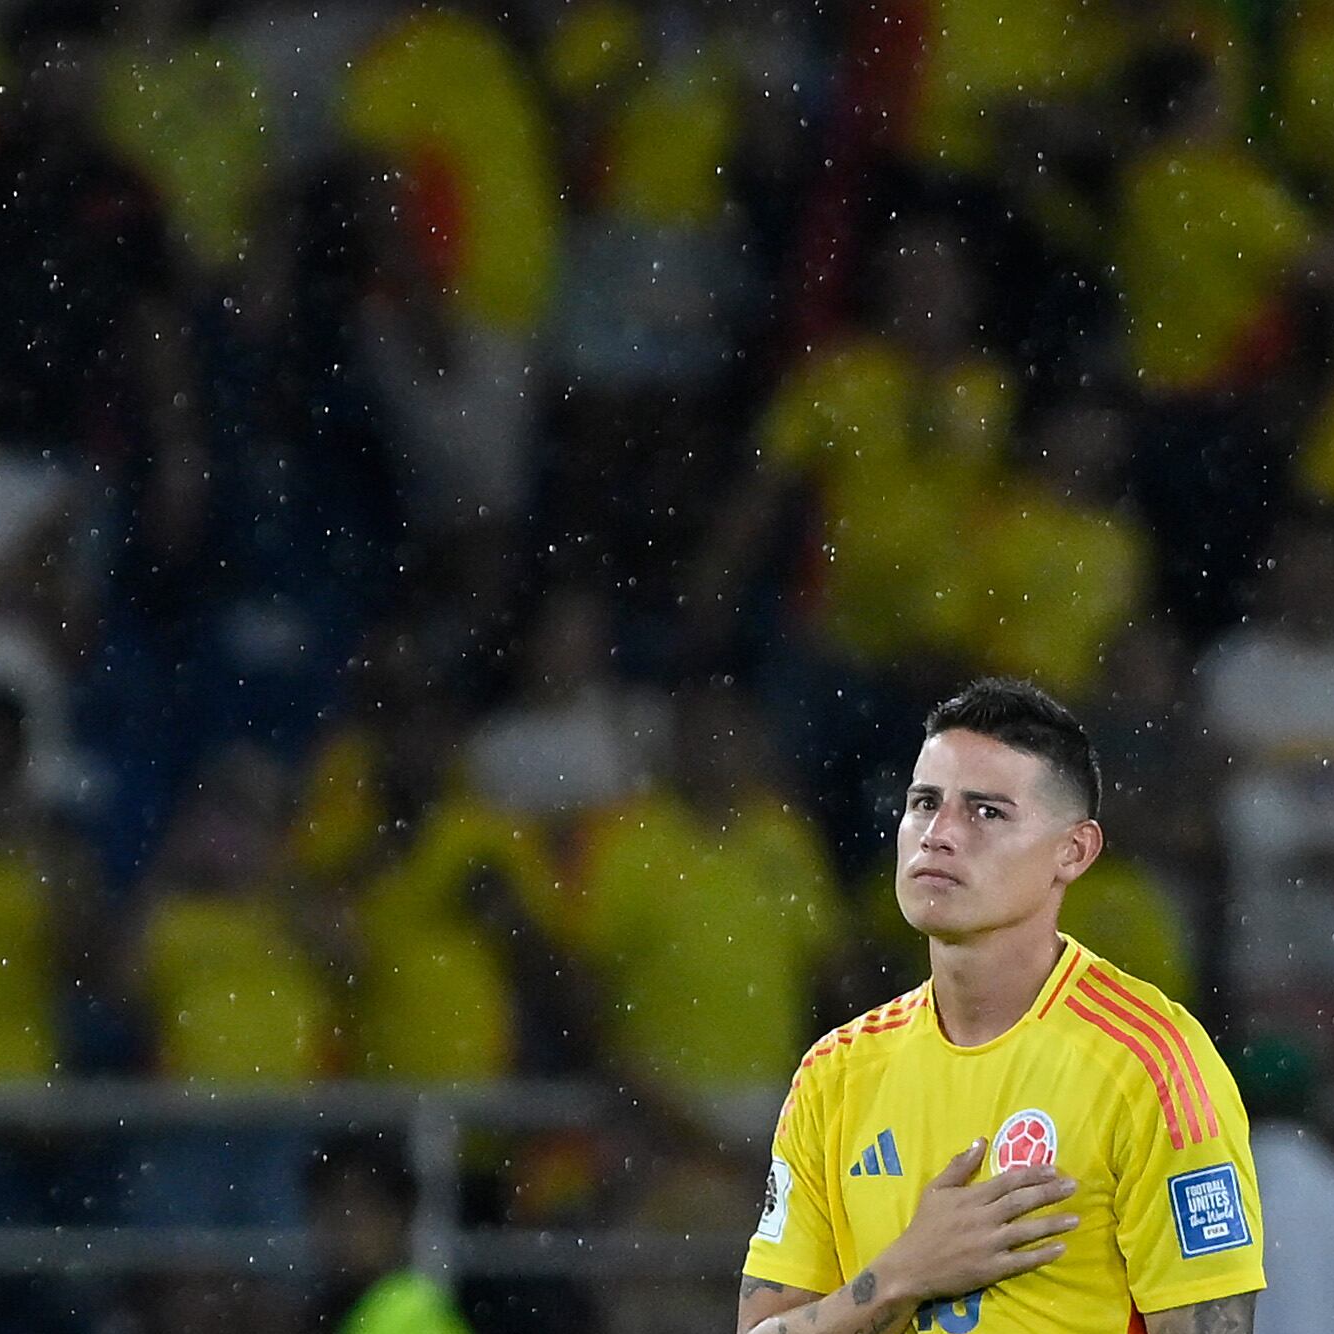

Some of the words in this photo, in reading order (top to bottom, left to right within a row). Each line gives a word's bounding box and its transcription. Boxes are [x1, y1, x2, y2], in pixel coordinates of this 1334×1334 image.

[1185, 1179, 1226, 1197] FOOTBALL
[1188, 1190, 1230, 1213] UNITES
[1189, 1213, 1206, 1228] the
[1206, 1205, 1234, 1223] World
[1207, 1225, 1225, 1236] FIFA
